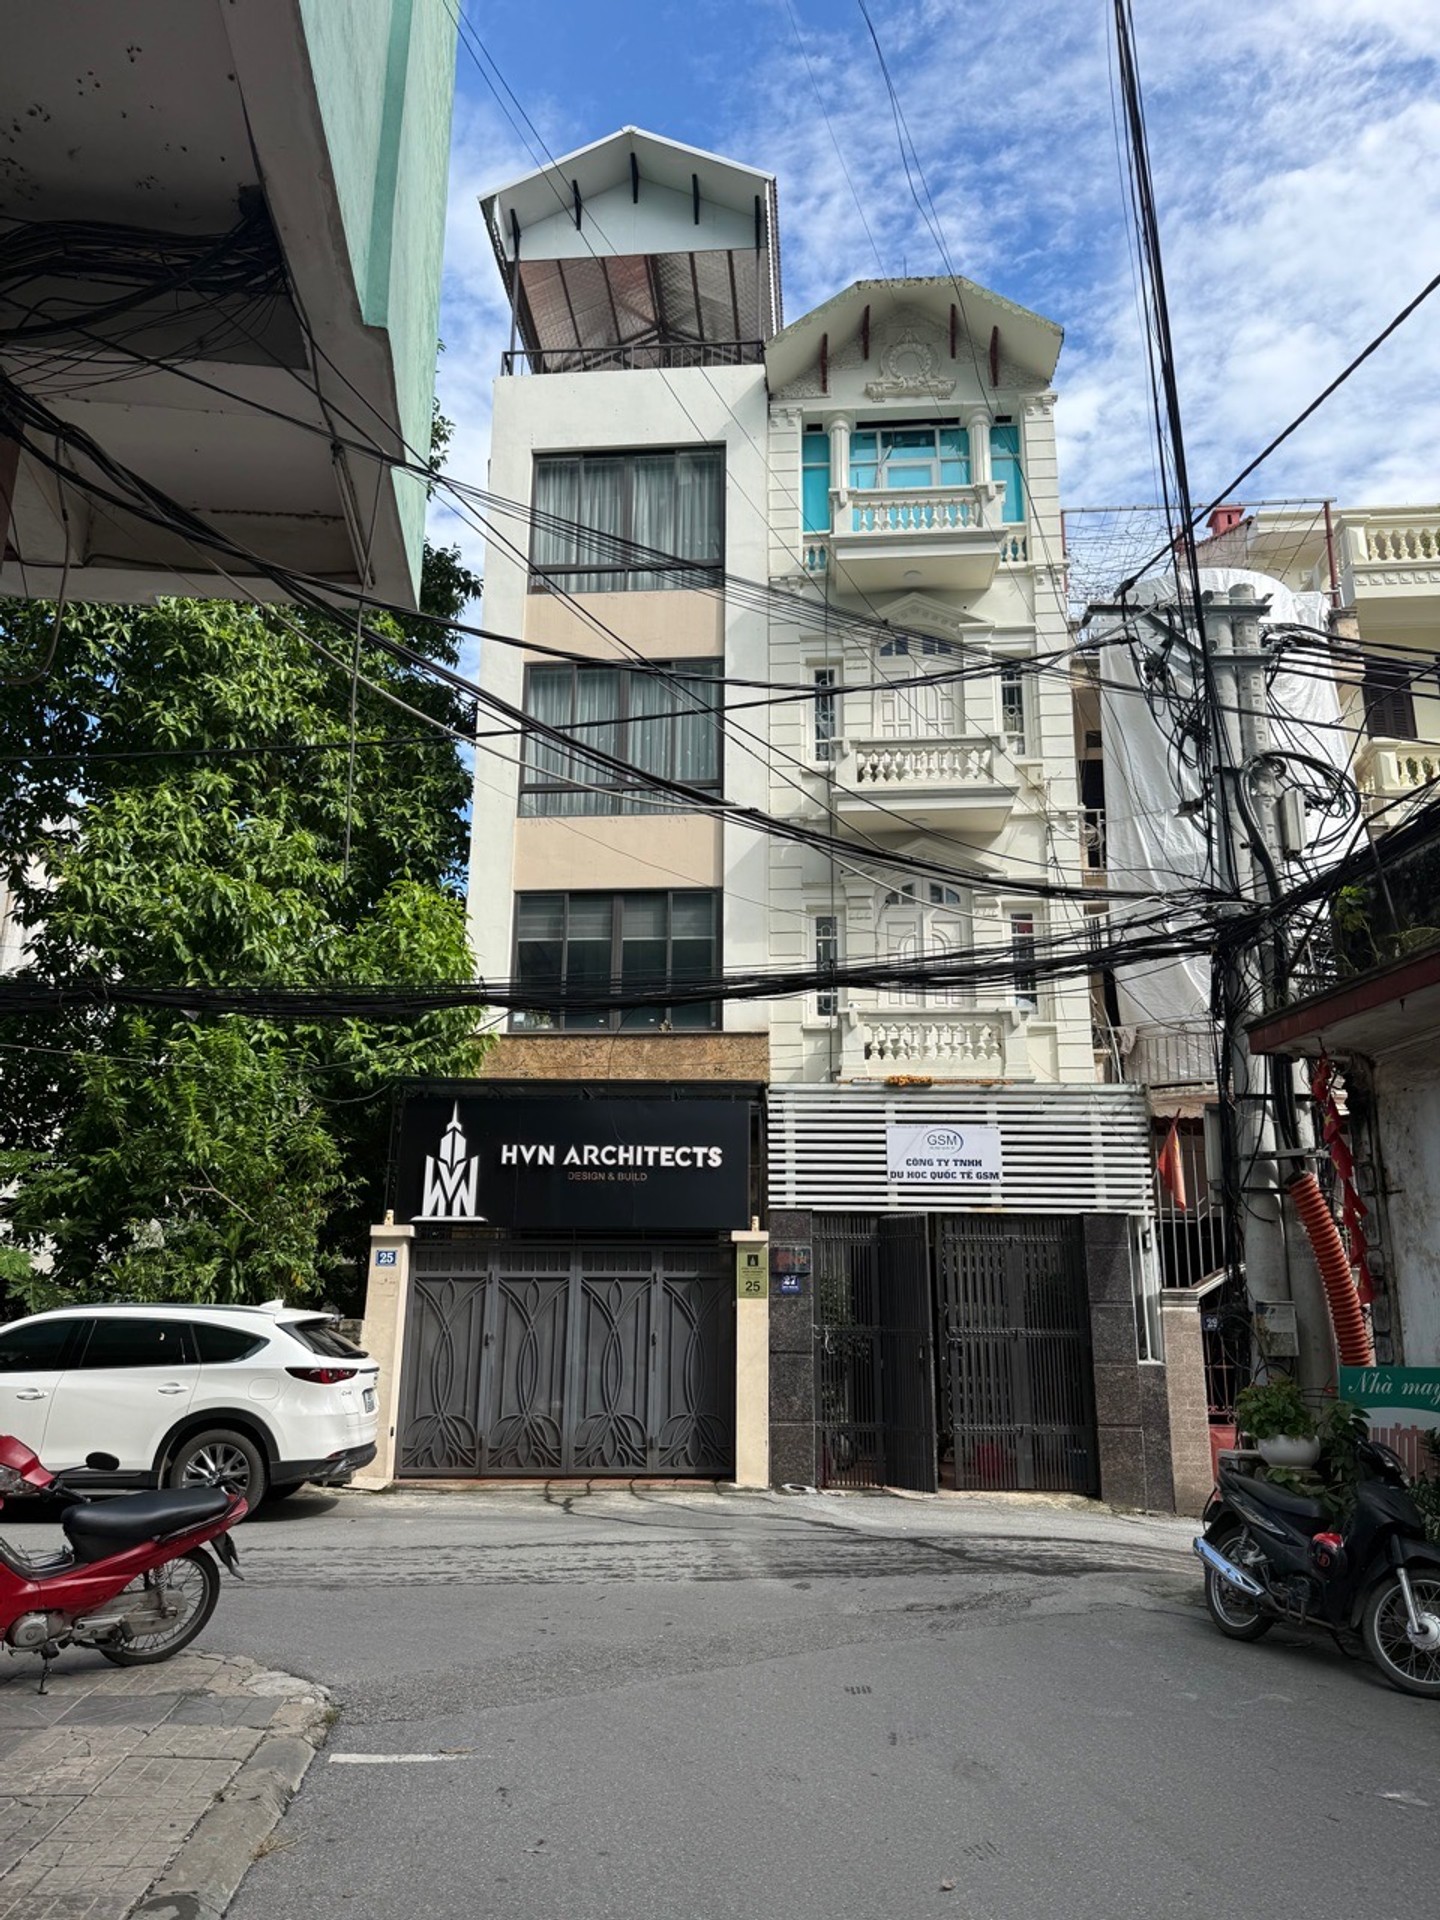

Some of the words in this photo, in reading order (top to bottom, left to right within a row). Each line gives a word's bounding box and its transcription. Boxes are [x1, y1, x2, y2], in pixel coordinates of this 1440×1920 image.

[927, 1134, 957, 1146] GSM
[501, 1144, 555, 1166] HVN
[563, 1144, 723, 1168] ARCHITECTS
[936, 1158, 949, 1167] TY
[952, 1158, 982, 1167] TNHH
[567, 1171, 605, 1181] DESIGN
[607, 1171, 615, 1181] &
[617, 1171, 648, 1182] BUILD
[890, 1171, 904, 1179] DU
[976, 1171, 999, 1180] GSM
[379, 1252, 394, 1263] 25
[745, 1280, 761, 1292] 25
[783, 1275, 798, 1286] 27
[1348, 1371, 1393, 1394] Nhà
